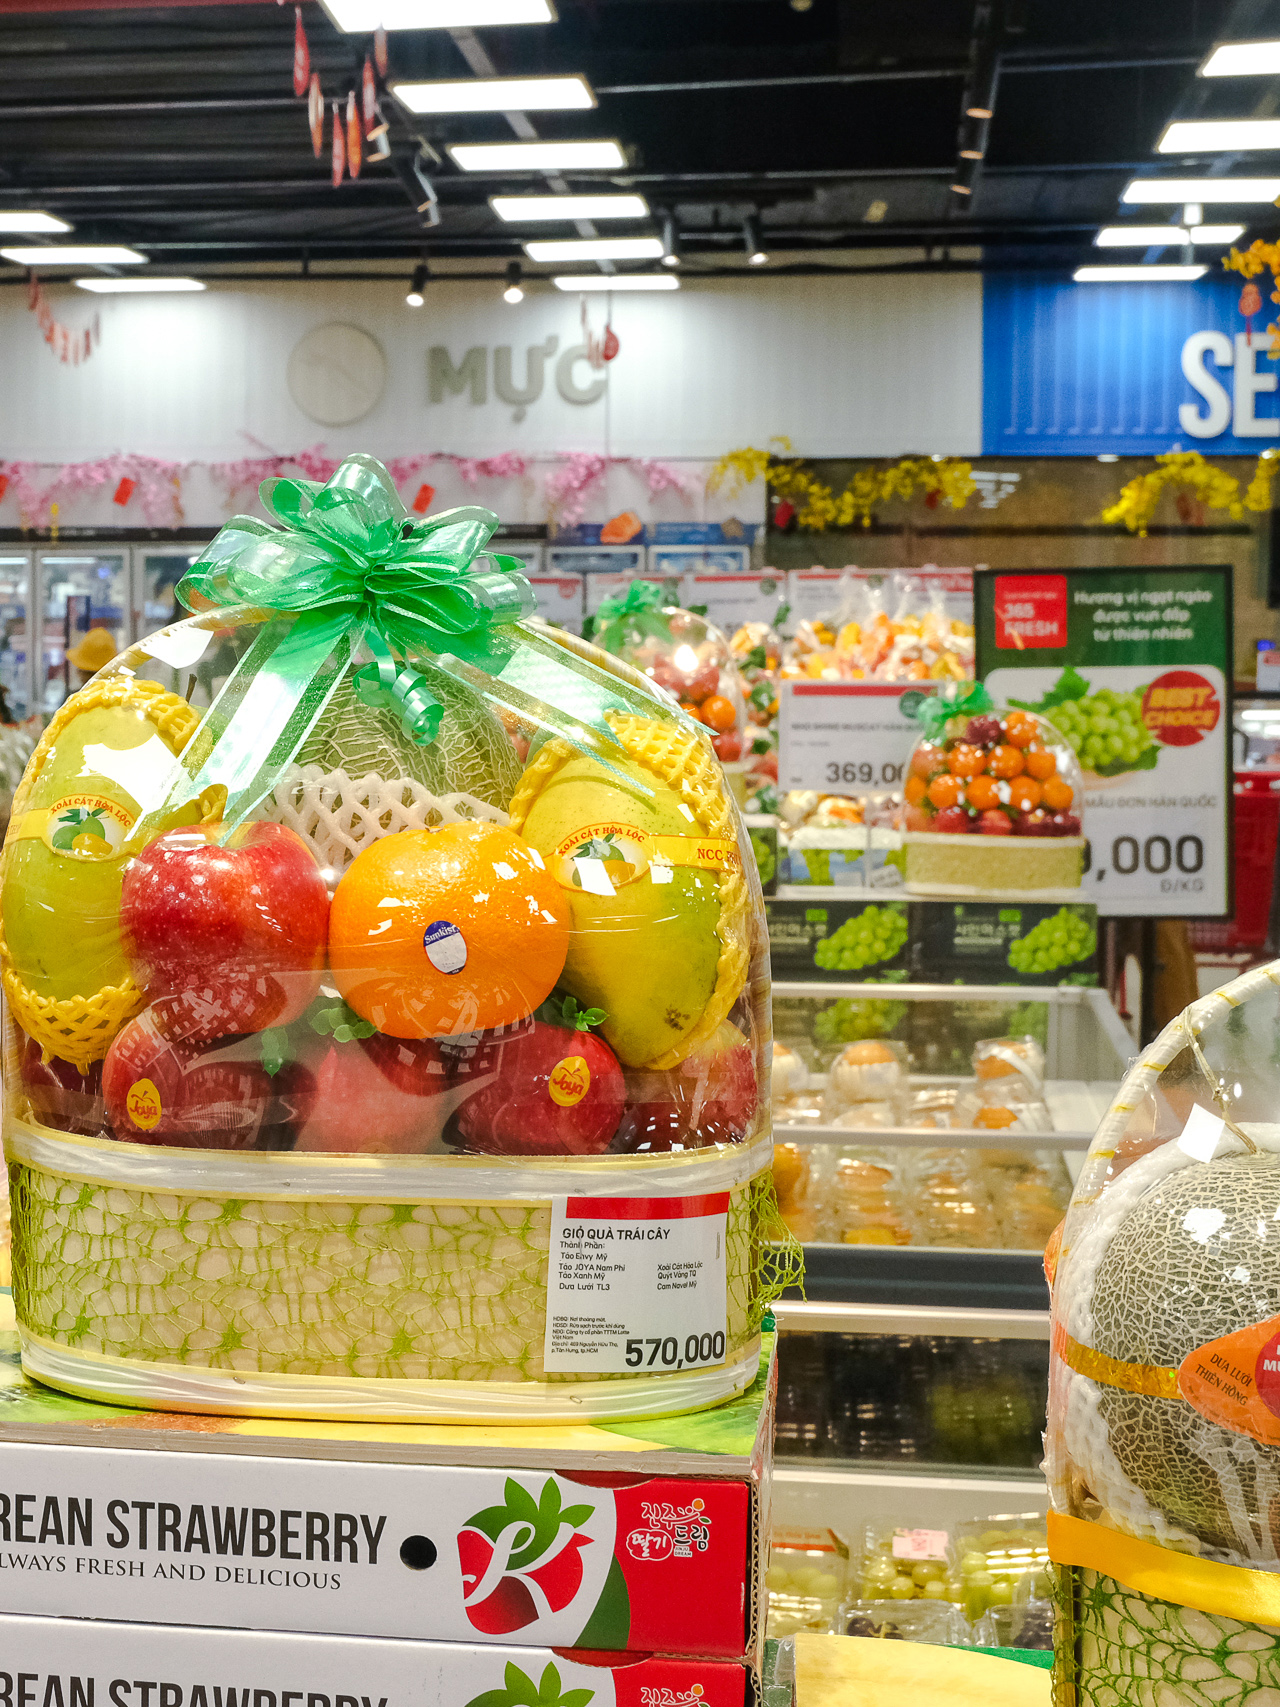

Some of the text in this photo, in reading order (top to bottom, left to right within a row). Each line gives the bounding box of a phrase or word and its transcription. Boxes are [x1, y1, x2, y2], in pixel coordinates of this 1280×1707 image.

[427, 335, 609, 423] MỰC
[1149, 688, 1212, 708] BEST
[1145, 711, 1215, 727] CHOICE
[50, 799, 72, 814] XOÀI
[74, 797, 93, 805] CÁT
[115, 810, 131, 827] LỘC
[558, 835, 579, 856] XOÀI
[581, 828, 599, 840] CÁT
[626, 829, 645, 843] LỘC
[697, 848, 723, 861] NCC
[425, 925, 458, 944] Sunkist
[553, 1074, 584, 1095] Joya
[129, 1100, 158, 1119] Joya
[563, 1226, 670, 1240] GIỎ QUÀ TRÁI CÂY
[584, 1241, 605, 1249] Phần:
[596, 1253, 608, 1261] Mỹ
[594, 1272, 605, 1280] Mỹ
[614, 1264, 625, 1272] Phi
[625, 1331, 725, 1368] 570,000
[1210, 1353, 1253, 1387] DƯA LƯỚI
[106, 1499, 388, 1565] STRAWBERRY
[674, 1524, 709, 1552] 드림
[632, 1533, 668, 1557] 딸기
[75, 1556, 146, 1579] FRESH
[152, 1563, 206, 1582] AND
[214, 1566, 342, 1591] DELICIOUS
